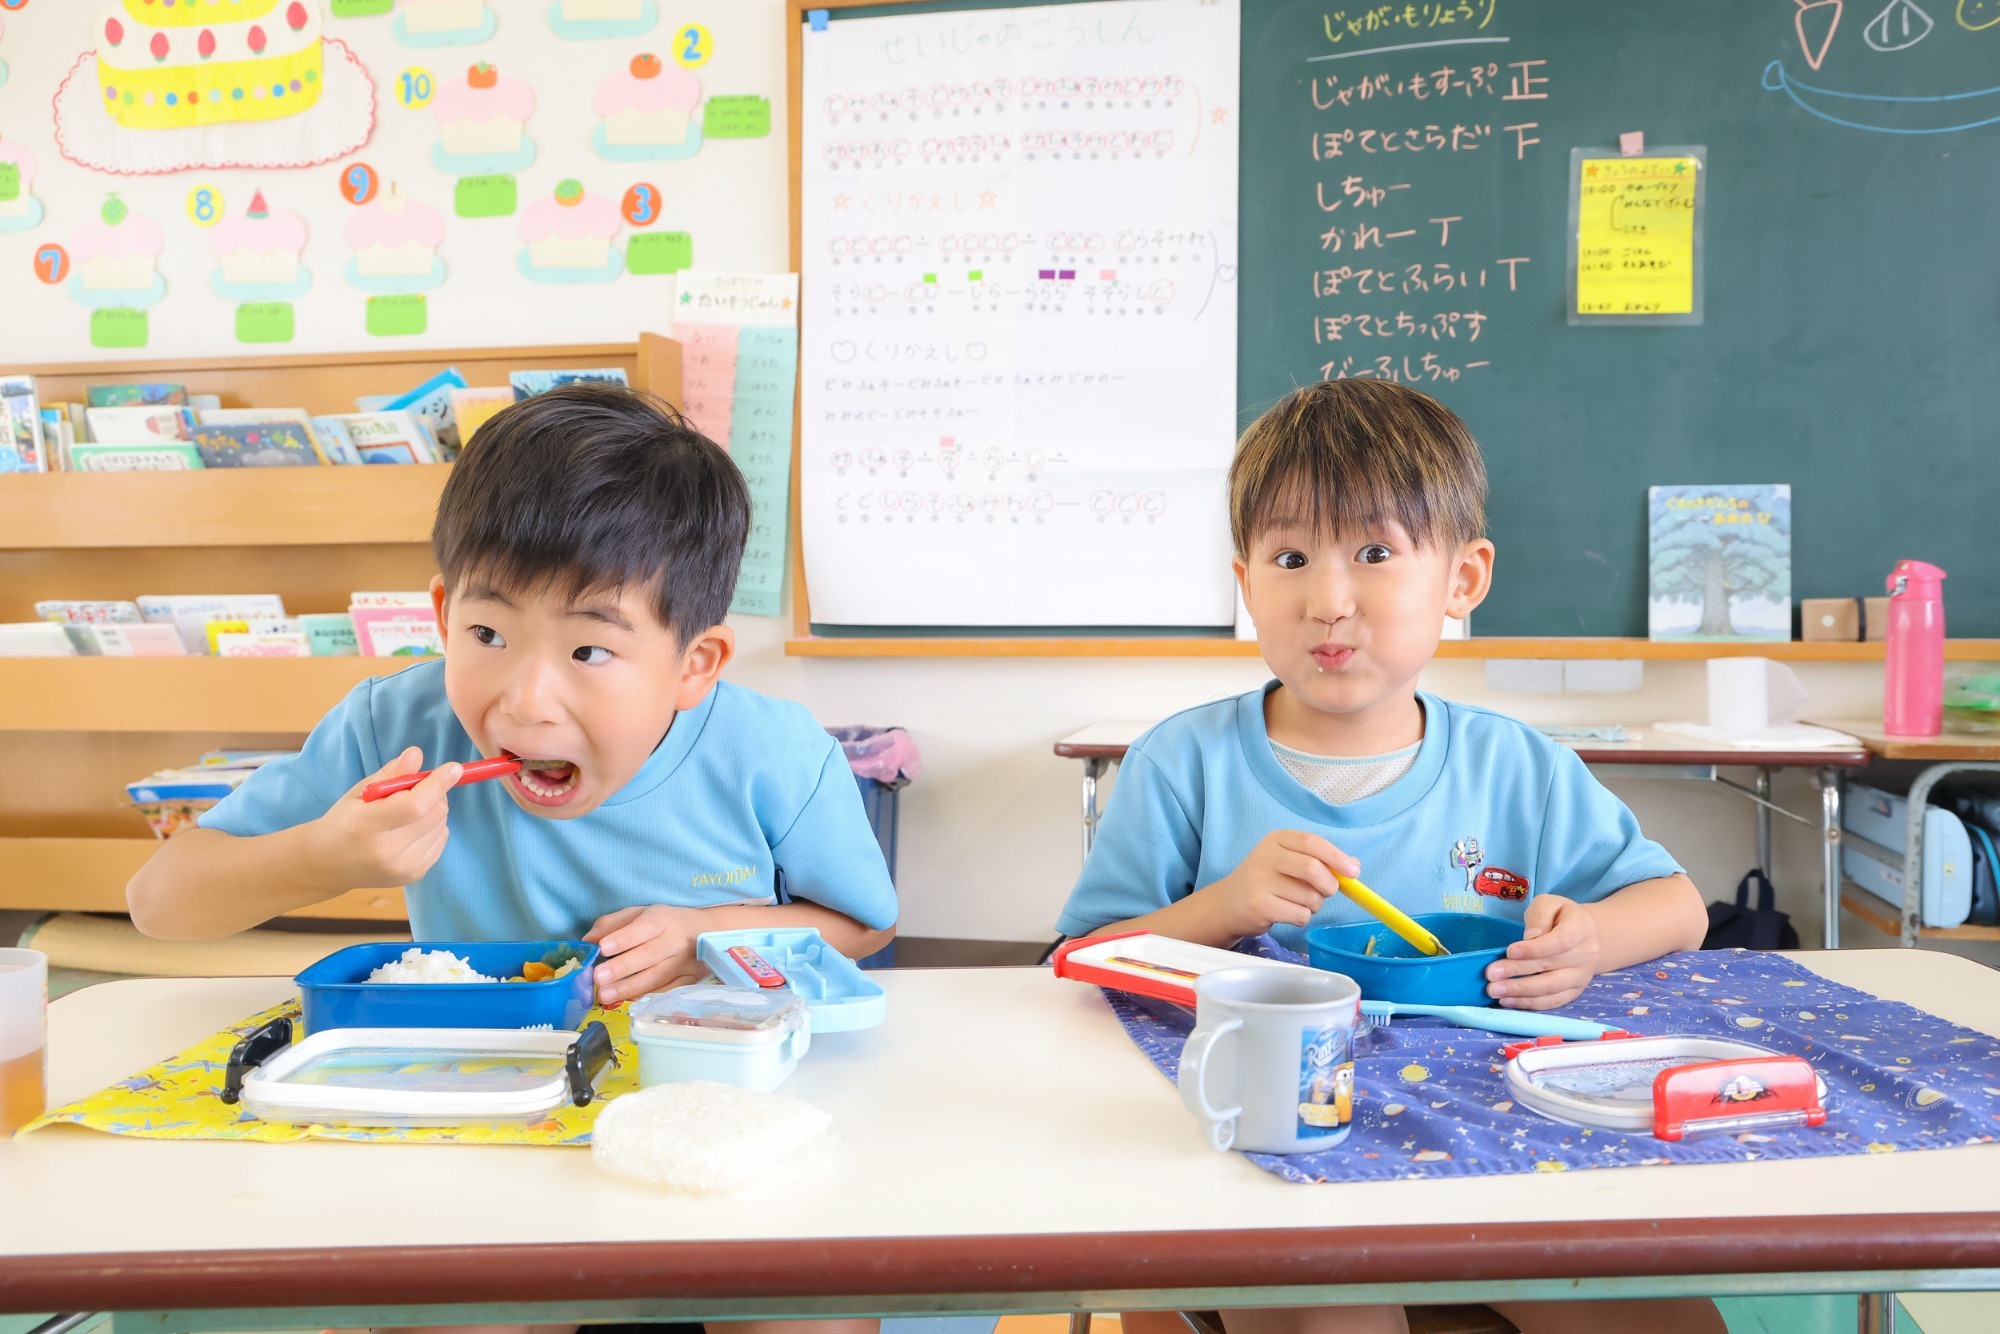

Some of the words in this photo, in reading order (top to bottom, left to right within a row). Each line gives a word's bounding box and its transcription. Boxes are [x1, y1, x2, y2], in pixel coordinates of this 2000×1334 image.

[682, 29, 701, 60] 2
[881, 13, 1156, 64] せいじゃのこうしん
[402, 74, 431, 101] 10
[1311, 63, 1500, 110] じゃがいもすーぷ
[1502, 60, 1549, 101] 正
[1312, 124, 1491, 161] ぽてとさらだ
[346, 167, 369, 202] 9
[1317, 175, 1412, 213] しちゅー
[195, 189, 214, 219] 8
[631, 185, 652, 218] 3
[862, 192, 970, 213] くりかえし
[1320, 222, 1417, 252] かれー
[40, 248, 61, 280] 7
[1313, 262, 1487, 299] ぽてとふらい
[1314, 310, 1488, 344] ぽてとちっぷす
[865, 342, 958, 361] くりかえし
[1320, 352, 1490, 384] びーふしちゅー
